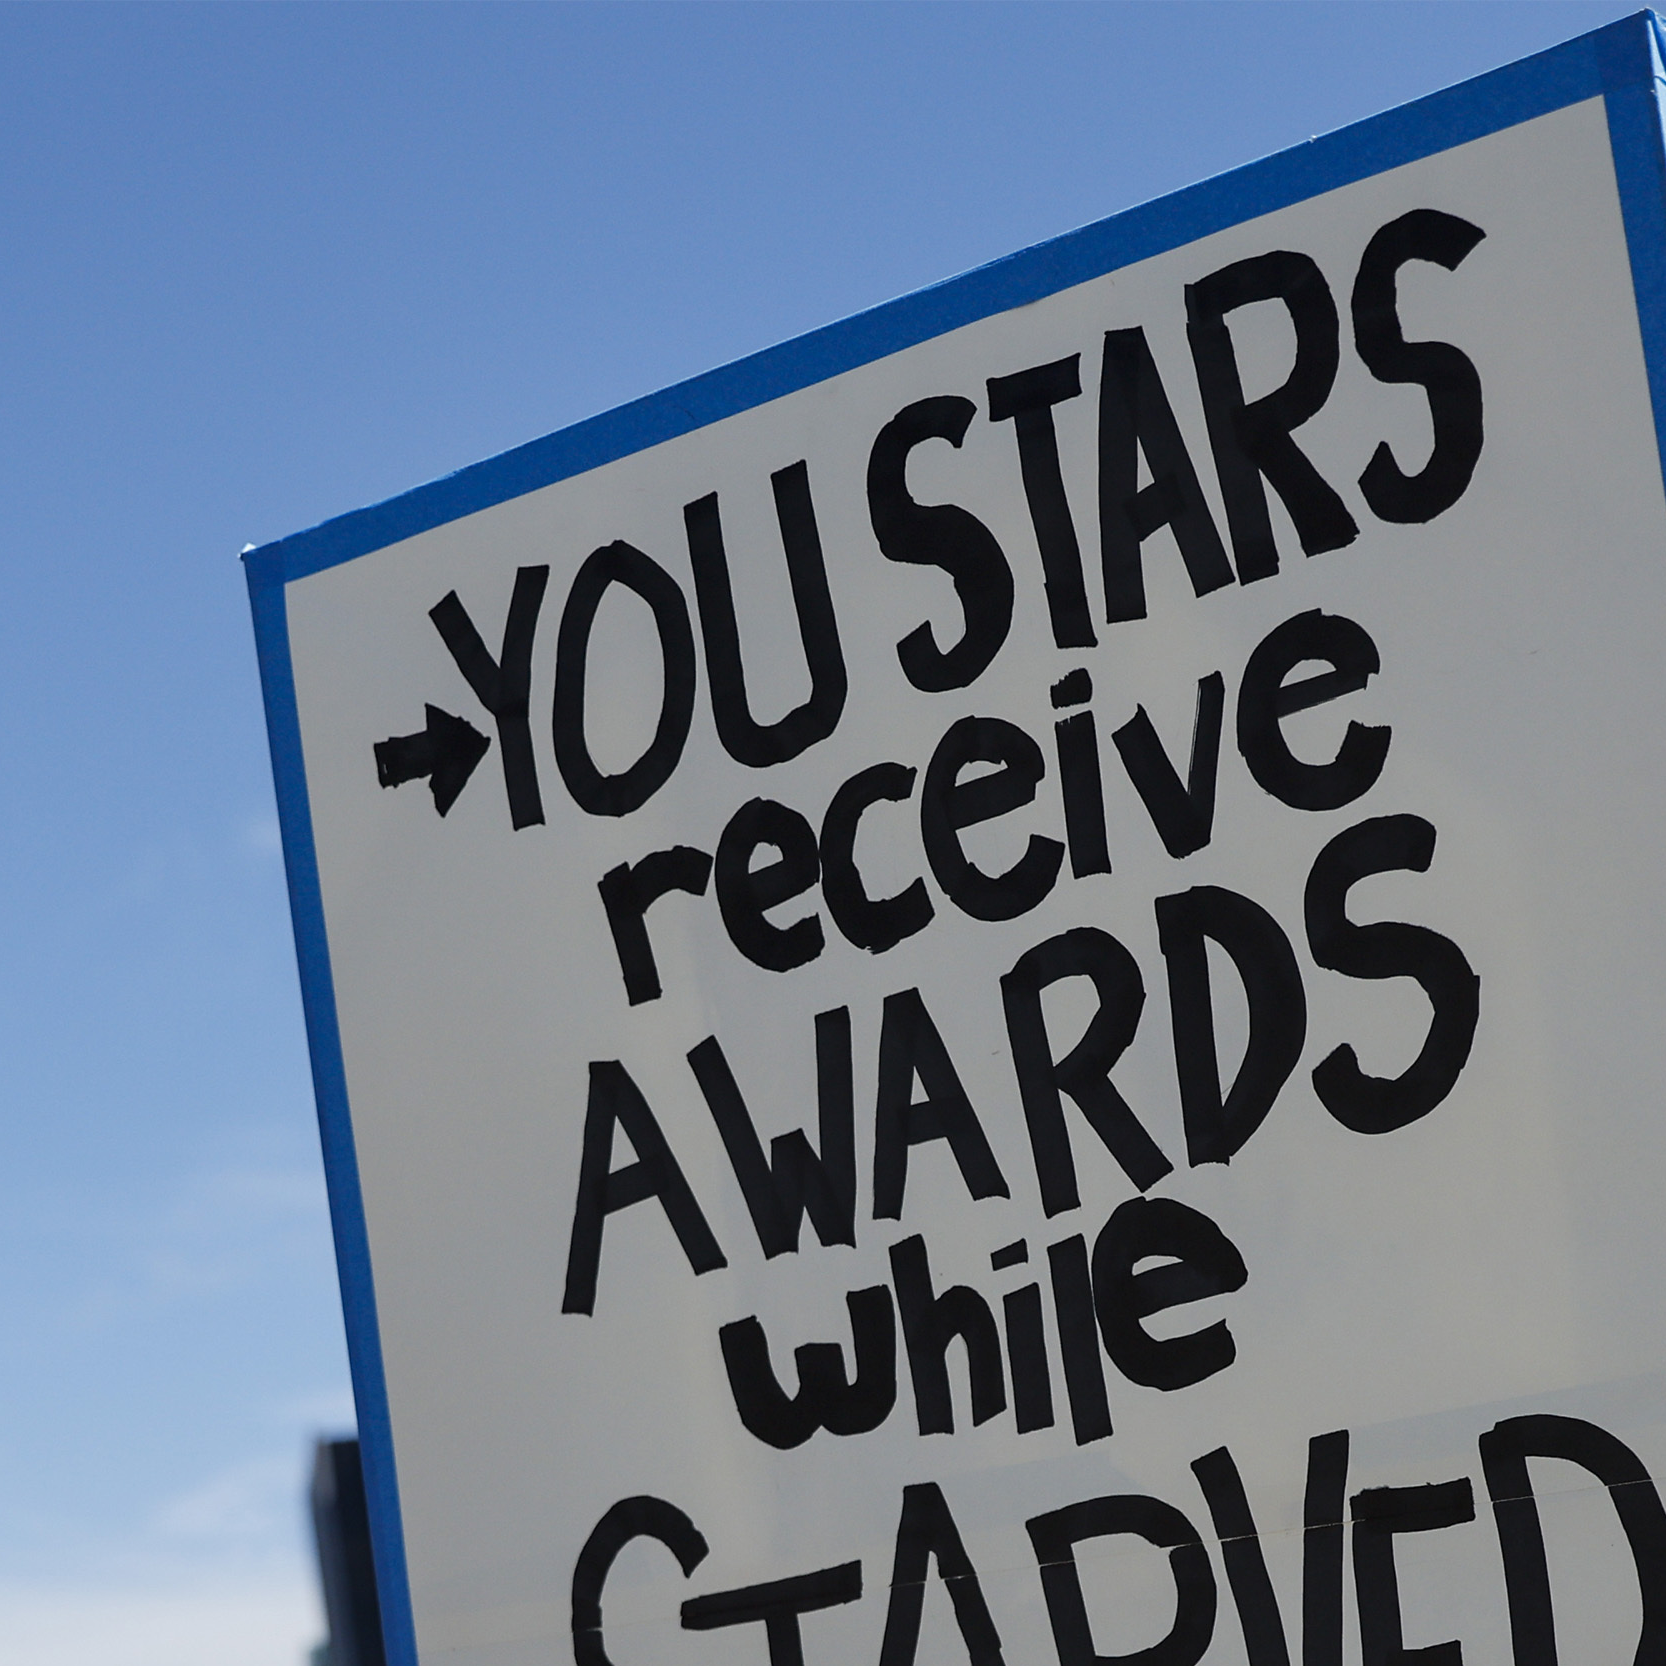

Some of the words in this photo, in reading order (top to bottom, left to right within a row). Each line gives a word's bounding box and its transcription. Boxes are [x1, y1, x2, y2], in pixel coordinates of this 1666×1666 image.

[428, 459, 847, 831] YOU
[867, 209, 1486, 693] STARS
[598, 608, 1392, 1006] receive
[561, 814, 1480, 1317] AWARDS
[719, 1196, 1248, 1450] while
